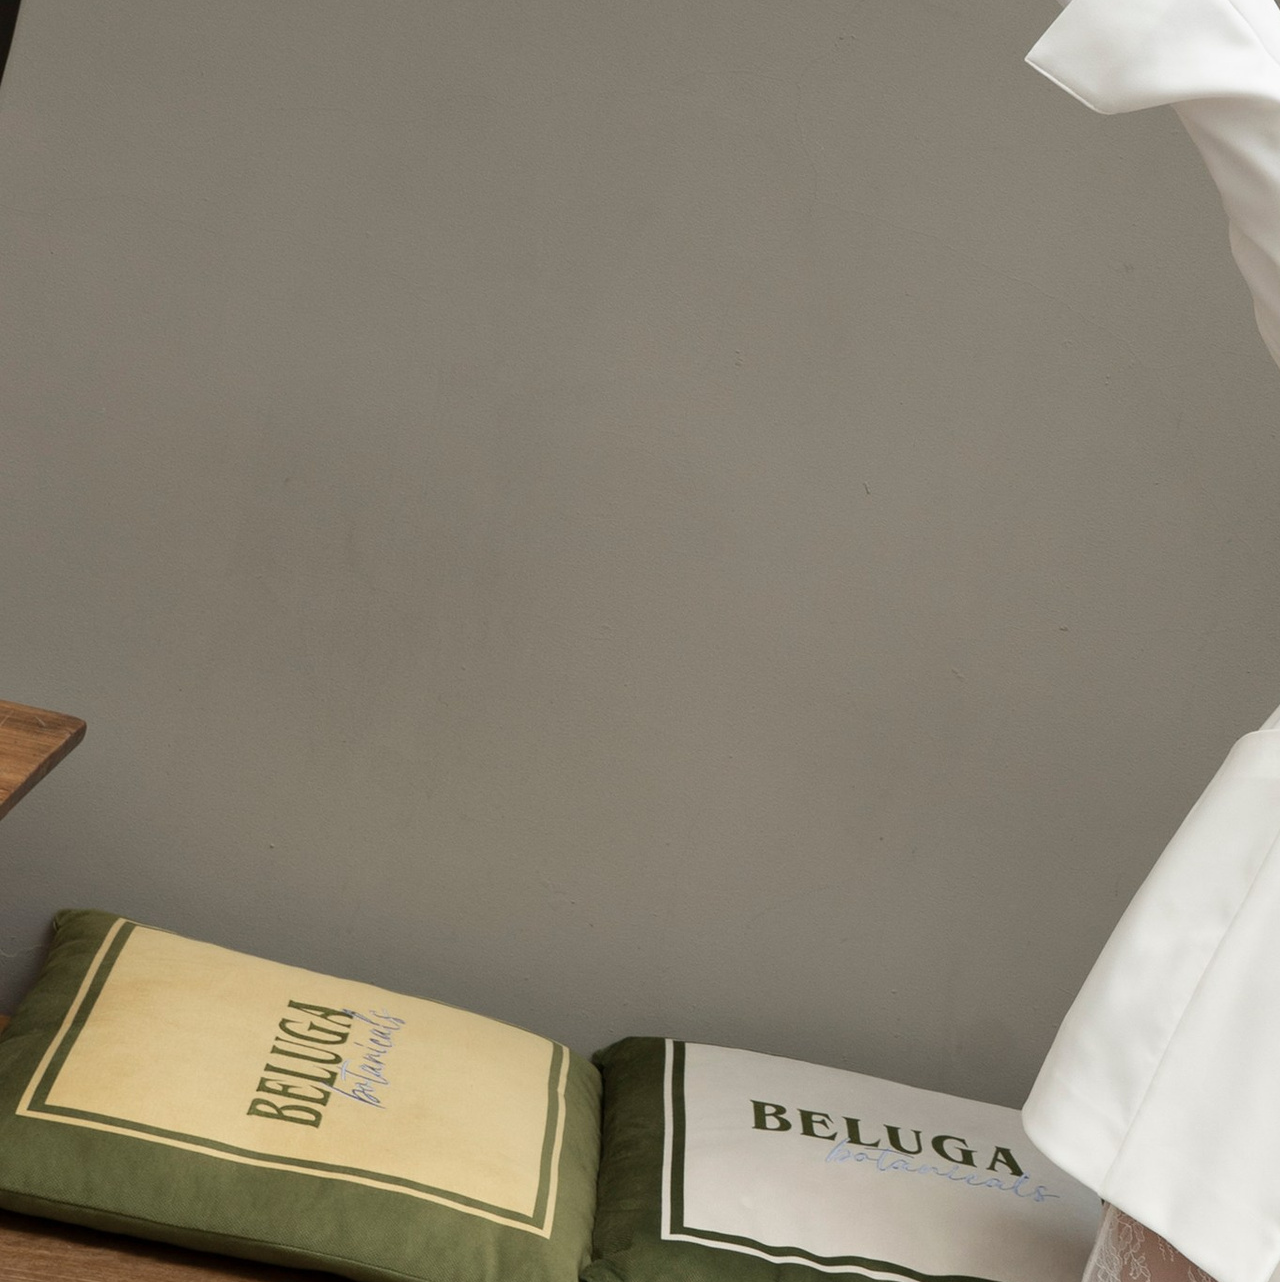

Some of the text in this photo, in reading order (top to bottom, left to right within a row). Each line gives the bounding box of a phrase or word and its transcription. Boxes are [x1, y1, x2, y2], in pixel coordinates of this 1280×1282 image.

[246, 1000, 353, 1129] BELUGA
[320, 1008, 406, 1109] botanicals
[749, 1099, 1029, 1178] BELUGA
[825, 1137, 1060, 1203] botanicals
